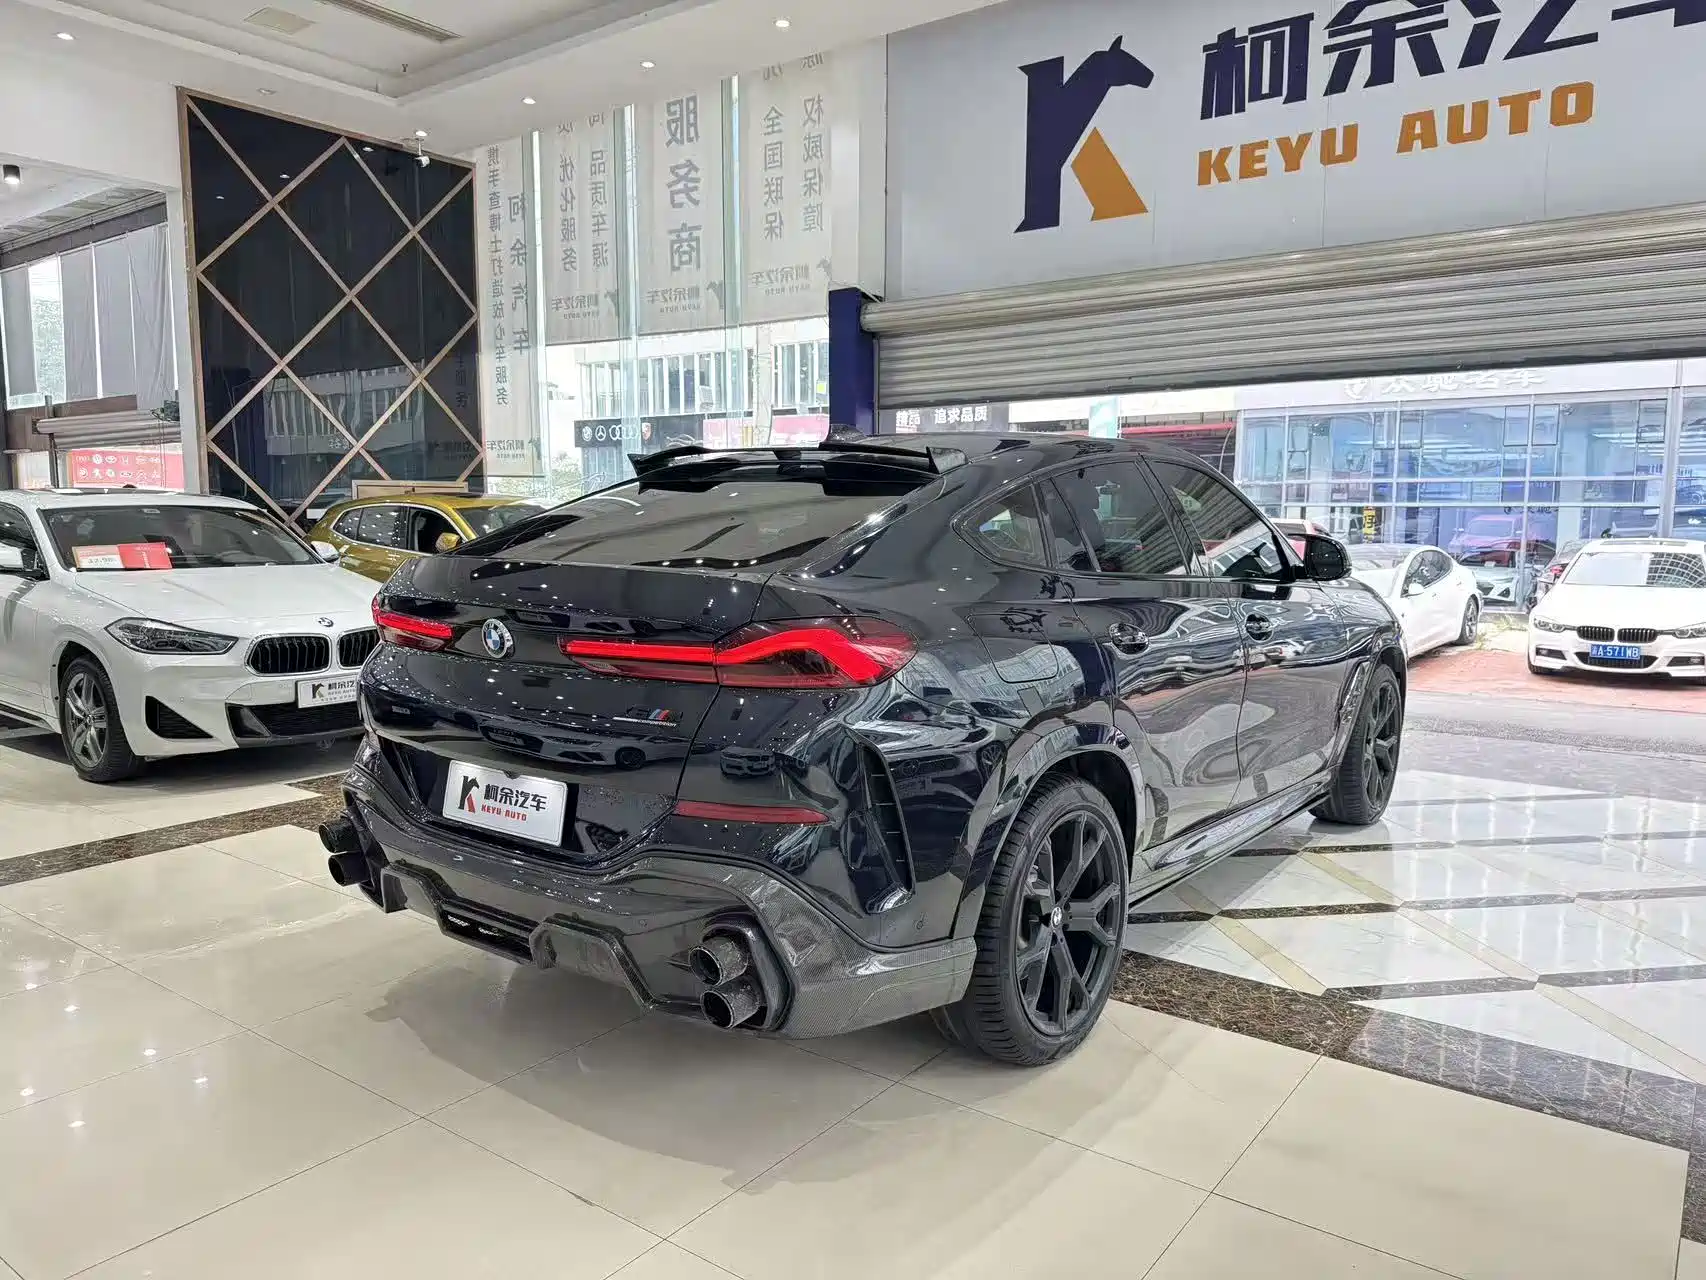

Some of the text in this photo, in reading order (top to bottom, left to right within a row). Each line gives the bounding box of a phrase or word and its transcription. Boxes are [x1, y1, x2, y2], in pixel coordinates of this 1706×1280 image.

[1200, 0, 1706, 120] 柯余汽
[1197, 81, 1595, 186] KEYU AUTO
[935, 405, 987, 424] 追求品质
[484, 783, 548, 812] 柯余汽车
[481, 804, 527, 821] KEYU AUTO
